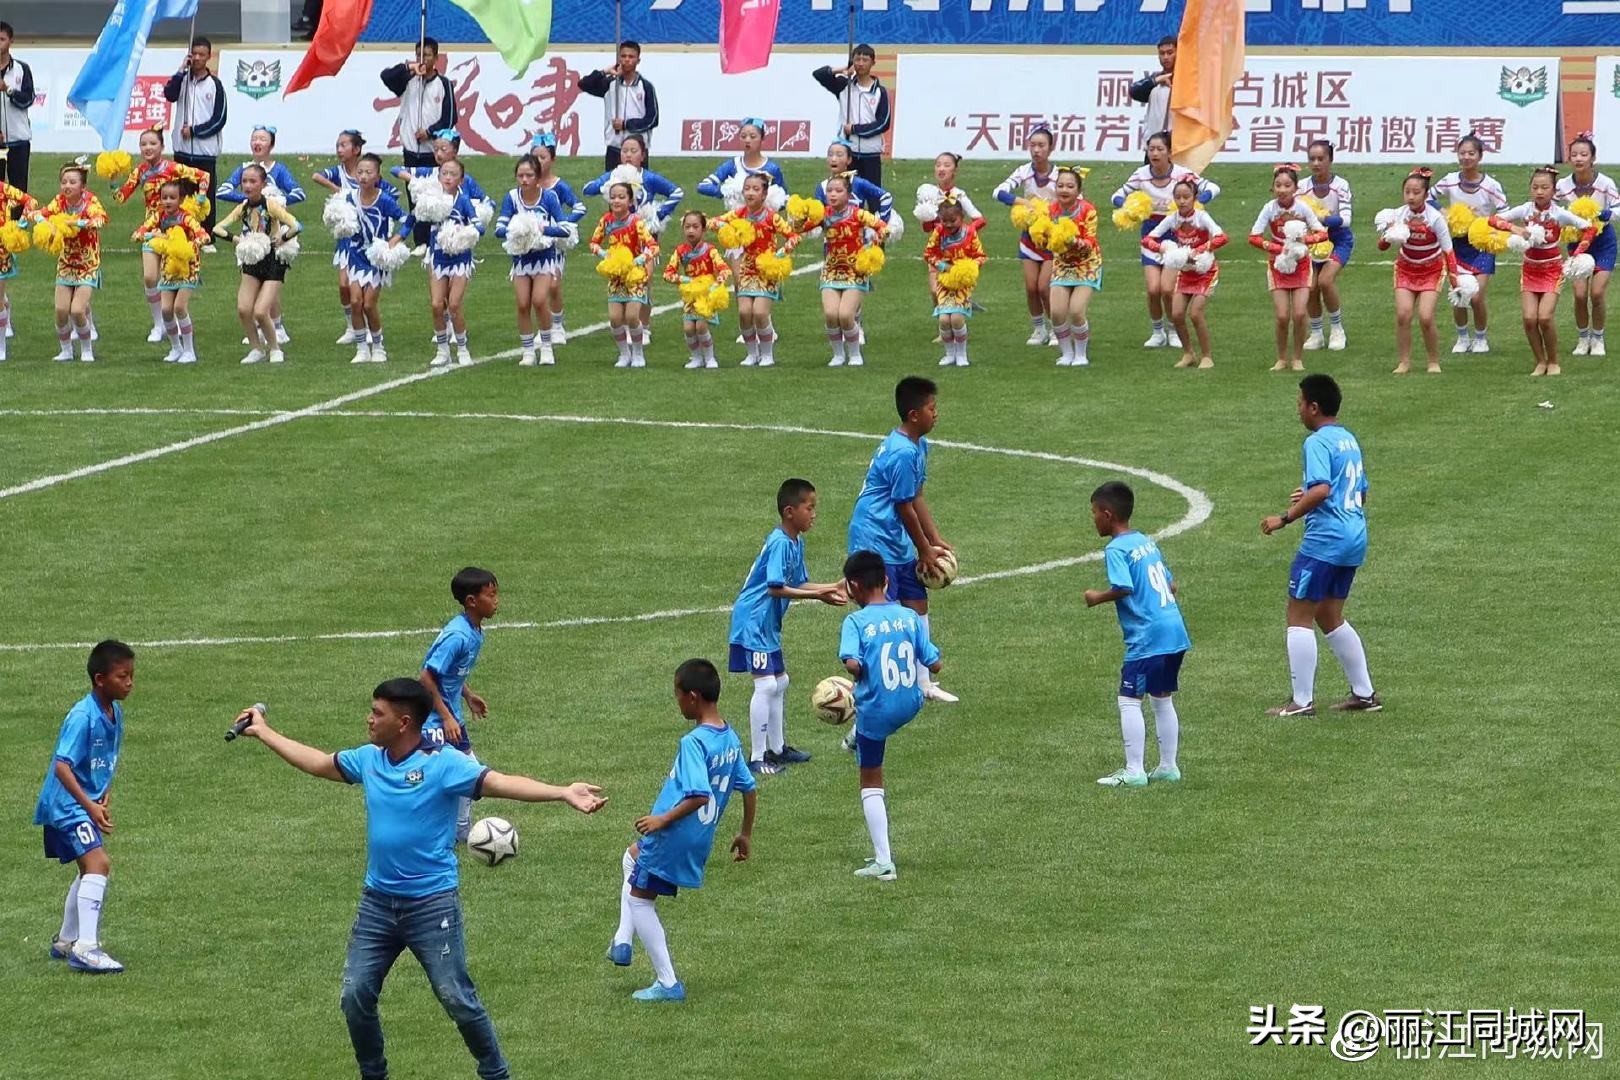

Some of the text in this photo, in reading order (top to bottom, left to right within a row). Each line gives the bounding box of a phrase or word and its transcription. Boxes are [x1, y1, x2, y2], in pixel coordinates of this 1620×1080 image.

[753, 652, 768, 669] 89
[880, 641, 916, 691] 63
[76, 821, 95, 845] 67
